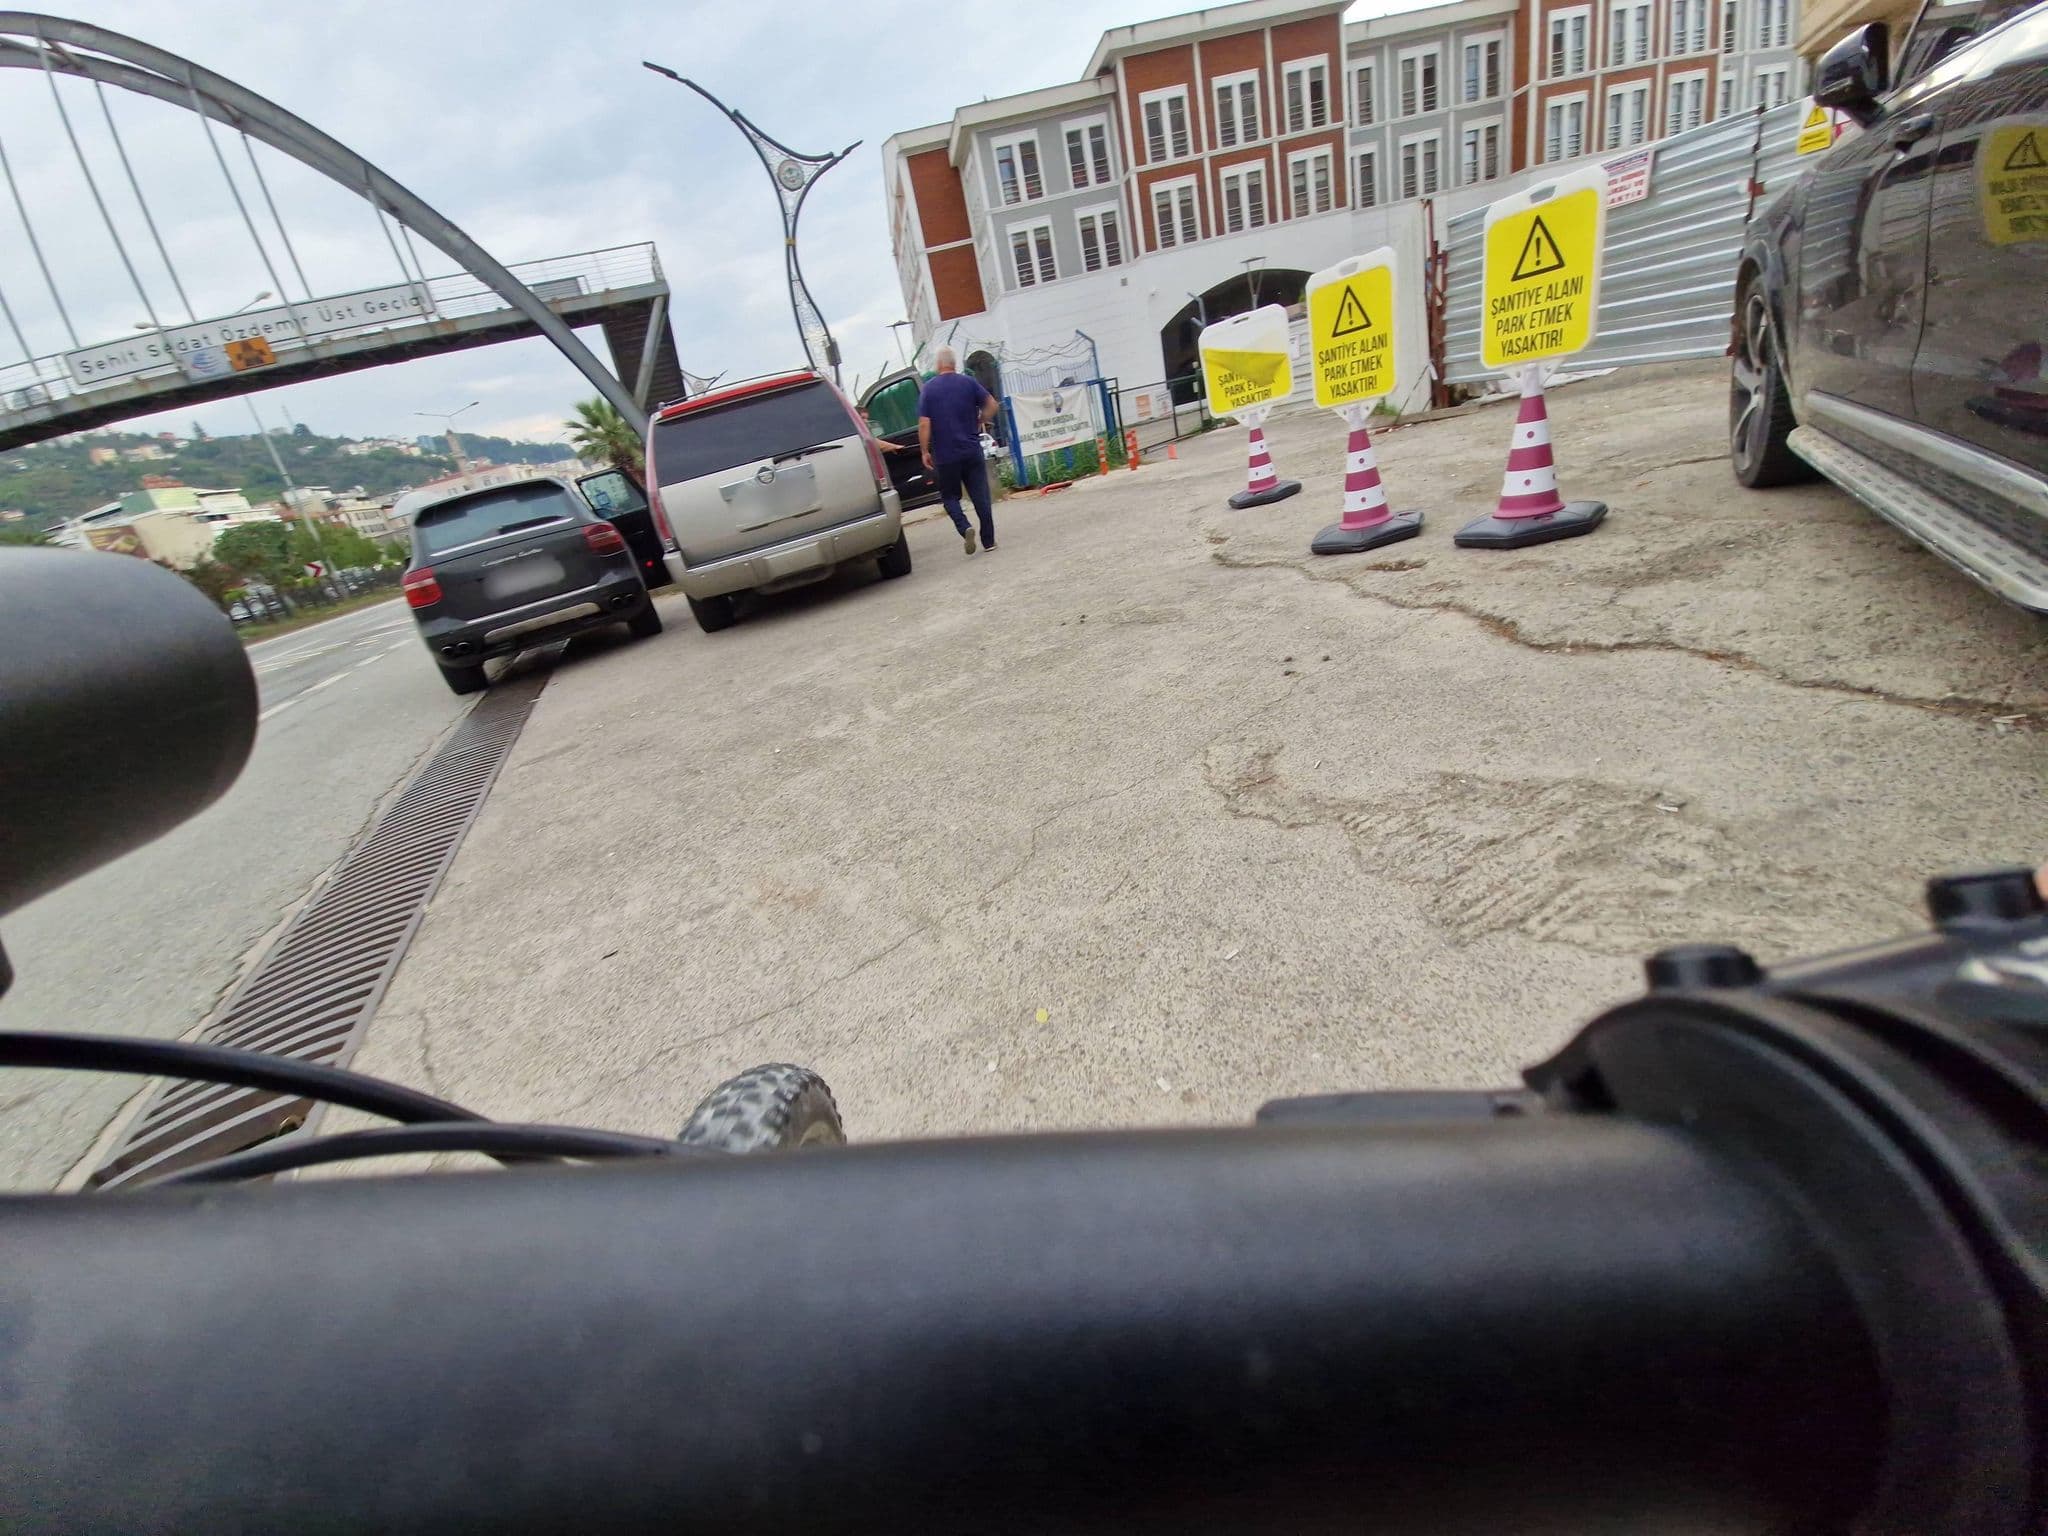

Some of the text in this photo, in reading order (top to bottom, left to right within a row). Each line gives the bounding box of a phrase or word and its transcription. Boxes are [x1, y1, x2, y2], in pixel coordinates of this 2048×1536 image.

[1491, 275, 1583, 319] ŞANTİYE ALANI
[317, 305, 356, 323] Üst
[1496, 302, 1574, 337] PARK ETMEK
[1318, 332, 1387, 368] ŞANTİYE ALANI
[1501, 328, 1563, 357] YASAKTIR!
[1324, 354, 1383, 382] PARK ETMEK
[1224, 384, 1246, 399] PARK
[1330, 374, 1377, 399] YASAKTIR!
